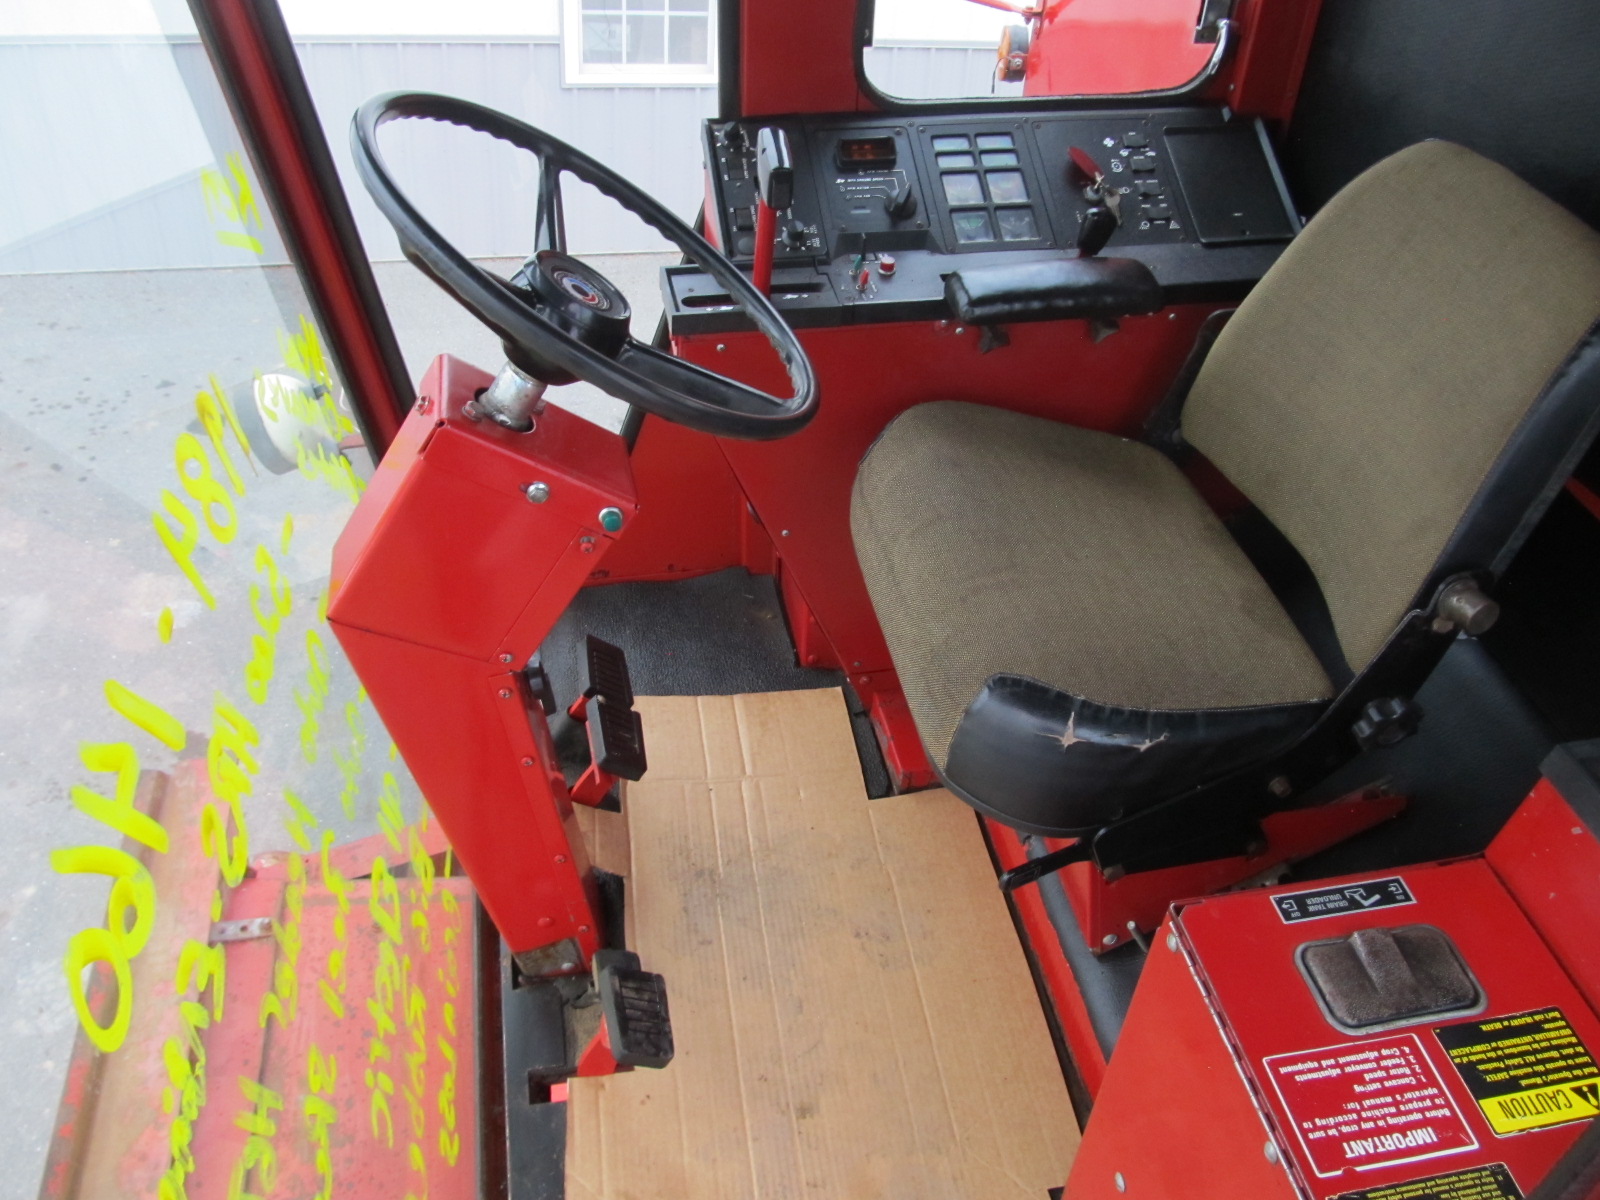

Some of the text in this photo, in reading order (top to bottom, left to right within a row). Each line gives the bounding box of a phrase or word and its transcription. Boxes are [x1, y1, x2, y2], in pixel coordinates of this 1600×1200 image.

[1306, 894, 1342, 904] UNLOADER
[1326, 900, 1348, 908] GRAIN
[1450, 1044, 1491, 1056] COMPLACENT
[1337, 1051, 1379, 1064] adjustment
[1380, 1058, 1405, 1066] Feeder
[1279, 1061, 1318, 1074] equipment
[1344, 1062, 1377, 1072] conveyor
[1390, 1067, 1411, 1075] Rotor
[1295, 1068, 1341, 1081] adjustments
[1364, 1070, 1386, 1080] speed
[1354, 1082, 1382, 1092] setting
[1384, 1077, 1416, 1086] Concave
[1396, 1087, 1438, 1100] operator's
[1362, 1096, 1392, 1107] manual
[1400, 1099, 1432, 1110] prepare
[1497, 1089, 1574, 1119] CAUTION
[1361, 1106, 1396, 1117] machine
[1425, 1108, 1450, 1117] Before
[1315, 1113, 1358, 1126] according
[1386, 1112, 1423, 1124] operating
[1327, 1128, 1338, 1136] be
[1343, 1127, 1437, 1158] IMPORTANT
